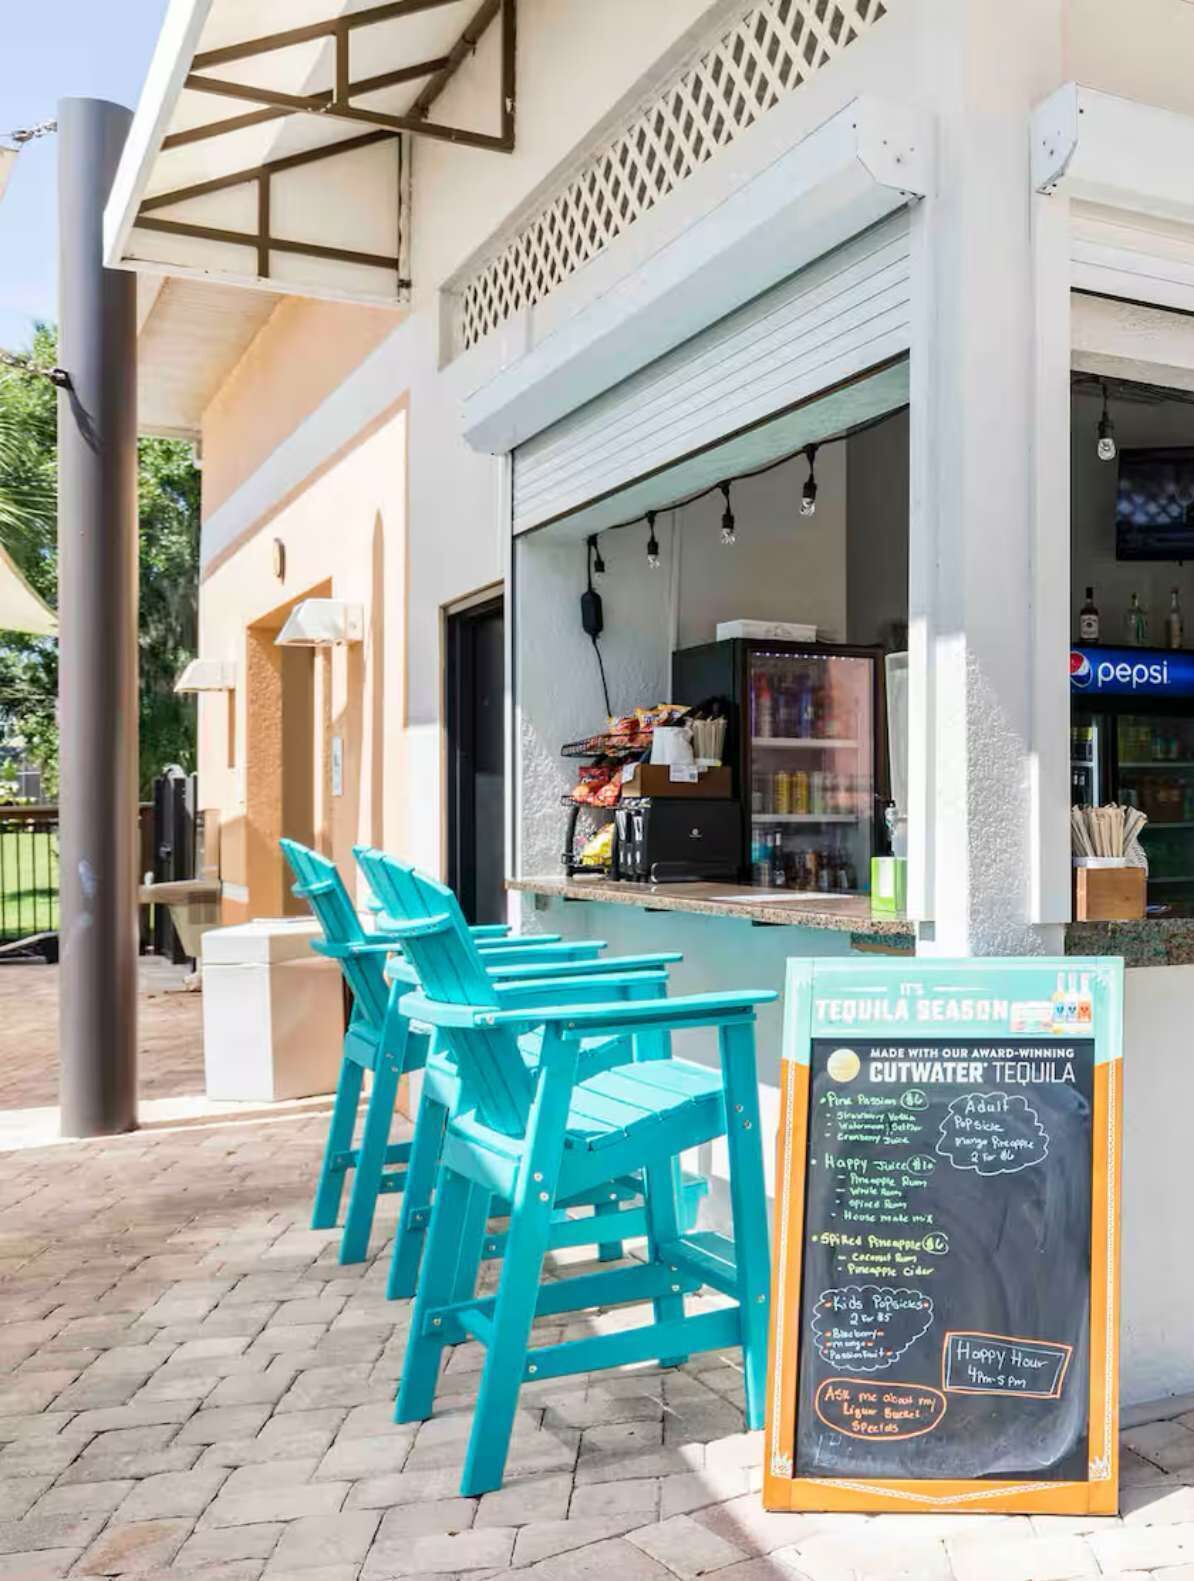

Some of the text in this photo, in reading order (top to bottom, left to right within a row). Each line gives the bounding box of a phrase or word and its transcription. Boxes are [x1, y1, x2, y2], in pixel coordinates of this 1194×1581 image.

[1098, 660, 1168, 688] pepsi
[900, 983, 924, 995] IT'S
[815, 1000, 1008, 1022] TEQUILA SEASON
[870, 1048, 1075, 1058] MADE WITH OUR AWARD-WINNING
[869, 1061, 1076, 1086] CUTWATER TEQUILA
[965, 1099, 1009, 1114] Adult
[825, 1152, 868, 1175] Happy
[971, 1151, 979, 1163] 2
[843, 1209, 876, 1222] House
[833, 1296, 863, 1311] Kids
[850, 1313, 859, 1325] 2
[957, 1340, 1049, 1370] Happy Hour
[858, 1392, 877, 1403] me
[883, 1392, 912, 1405] about
[918, 1397, 936, 1413] my
